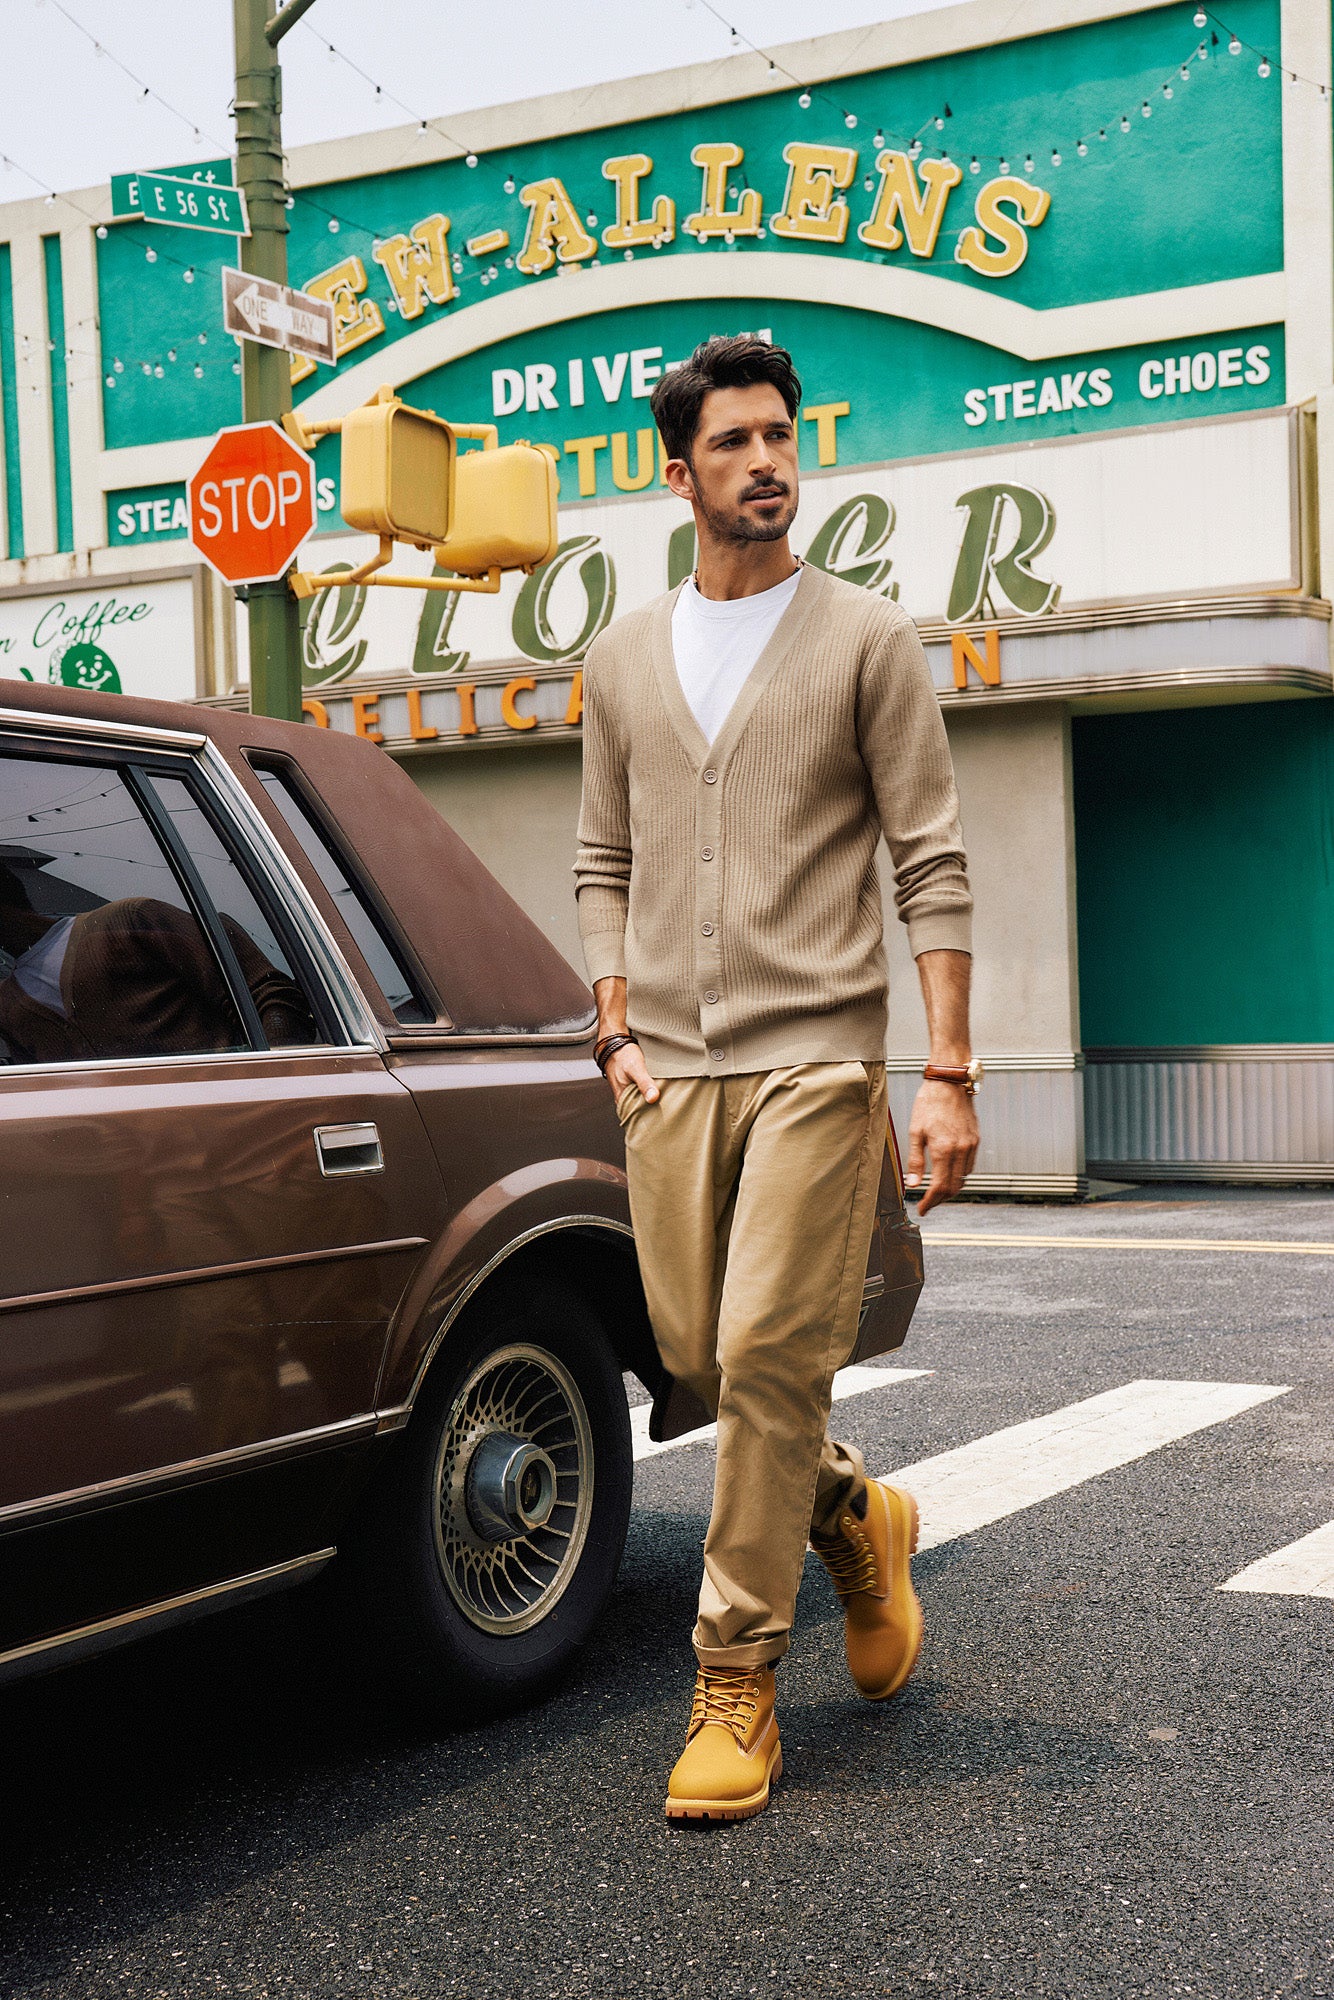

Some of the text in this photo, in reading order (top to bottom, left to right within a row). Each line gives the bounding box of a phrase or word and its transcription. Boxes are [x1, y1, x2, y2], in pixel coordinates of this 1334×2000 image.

[154, 186, 230, 222] E 56 St
[234, 141, 1051, 387] EW-ALLENS
[242, 295, 268, 322] ONE
[491, 327, 773, 417] DRIVE-
[963, 344, 1272, 427] STEAKS CHOES
[199, 469, 302, 538] STOP
[301, 480, 1063, 689] CLOER
[33, 598, 154, 648] Coffee
